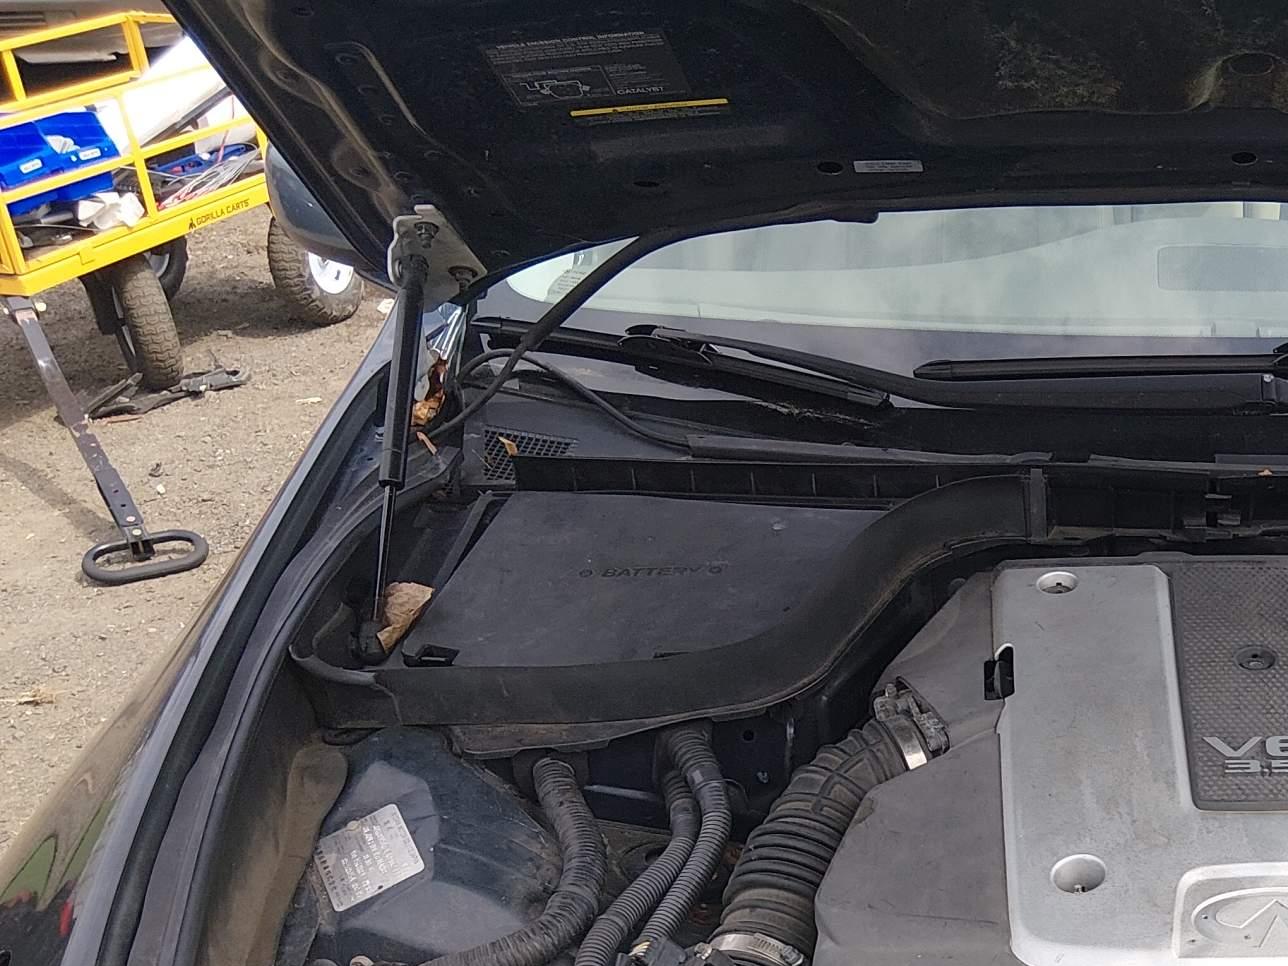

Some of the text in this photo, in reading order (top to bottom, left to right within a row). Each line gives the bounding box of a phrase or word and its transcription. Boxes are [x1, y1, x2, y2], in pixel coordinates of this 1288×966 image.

[616, 85, 664, 95] CATALYST
[196, 198, 250, 225] GORILLA CARTS
[601, 566, 701, 578] BATTERY
